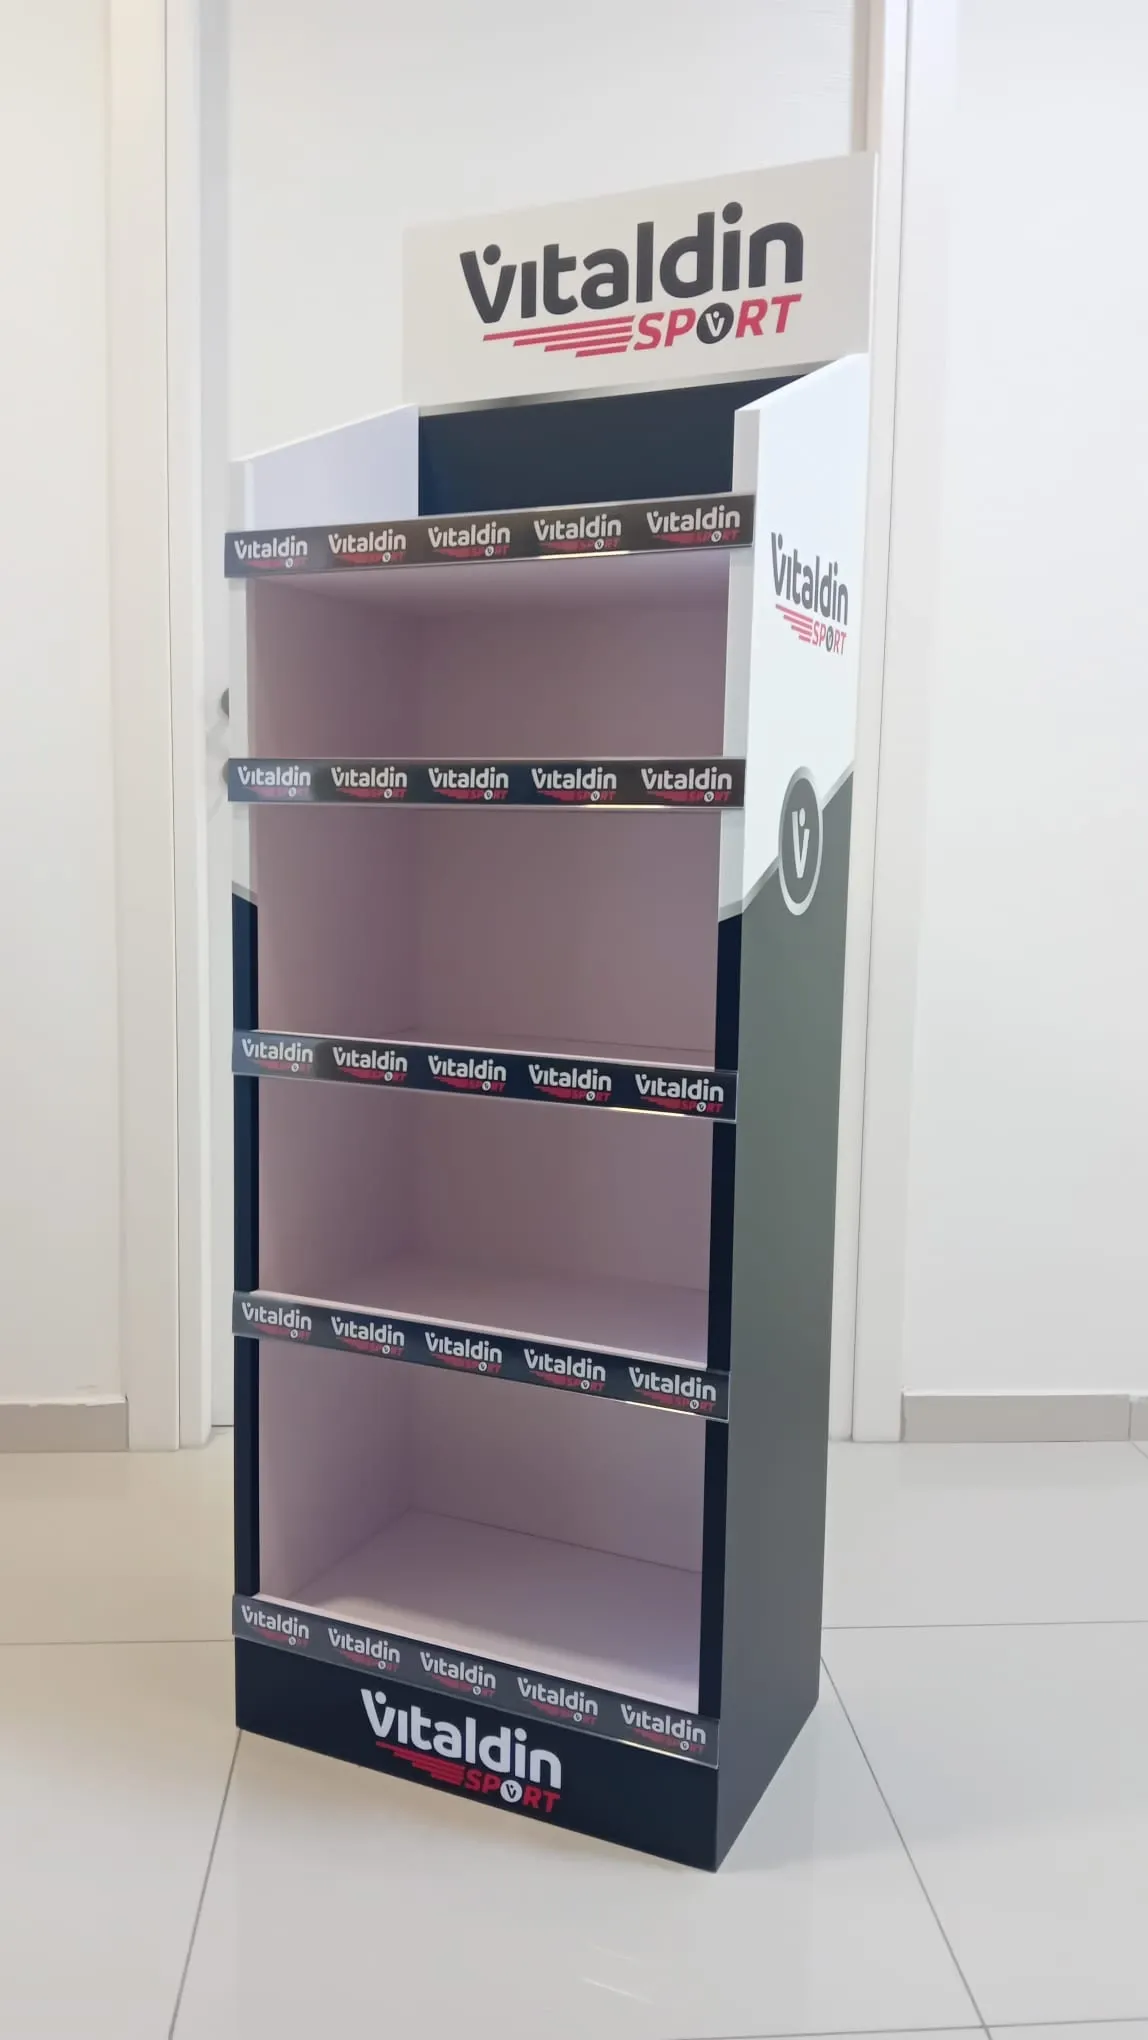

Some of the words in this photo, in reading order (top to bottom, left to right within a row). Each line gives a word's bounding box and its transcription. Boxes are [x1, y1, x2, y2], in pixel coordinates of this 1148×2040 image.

[459, 201, 804, 324] Vitaldin
[633, 293, 802, 351] SPORT
[234, 536, 308, 559] Vitaldin
[329, 529, 406, 554] Vitaldin
[428, 521, 511, 548] Vitaldin
[534, 514, 621, 541] Vitaldin
[647, 505, 740, 534] Vitaldin
[771, 532, 848, 626] Vitaldin
[812, 621, 847, 655] SPORT
[237, 765, 311, 786] Vitaldin
[331, 766, 407, 787] Vitaldin
[428, 767, 509, 789] Vitaldin
[531, 767, 617, 789] Vitaldin
[641, 766, 732, 790] Vitaldin
[241, 1038, 313, 1063] Vitaldin
[332, 1046, 408, 1072] Vitaldin
[427, 1055, 507, 1082] Vitaldin
[528, 1064, 612, 1091] Vitaldin
[634, 1074, 724, 1102] Vitaldin
[241, 1302, 311, 1331] Vitaldin
[331, 1316, 405, 1346] Vitaldin
[425, 1332, 503, 1363] Vitaldin
[524, 1348, 606, 1382] Vitaldin
[628, 1366, 717, 1401] Vitaldin
[241, 1604, 310, 1639] Vitaldin
[328, 1627, 401, 1663] Vitaldin
[420, 1651, 496, 1689] Vitaldin
[516, 1676, 599, 1717] Vitaldin
[620, 1703, 706, 1745] Vitaldin
[361, 1688, 562, 1790] Vitaldin
[464, 1769, 561, 1813] SPORT
